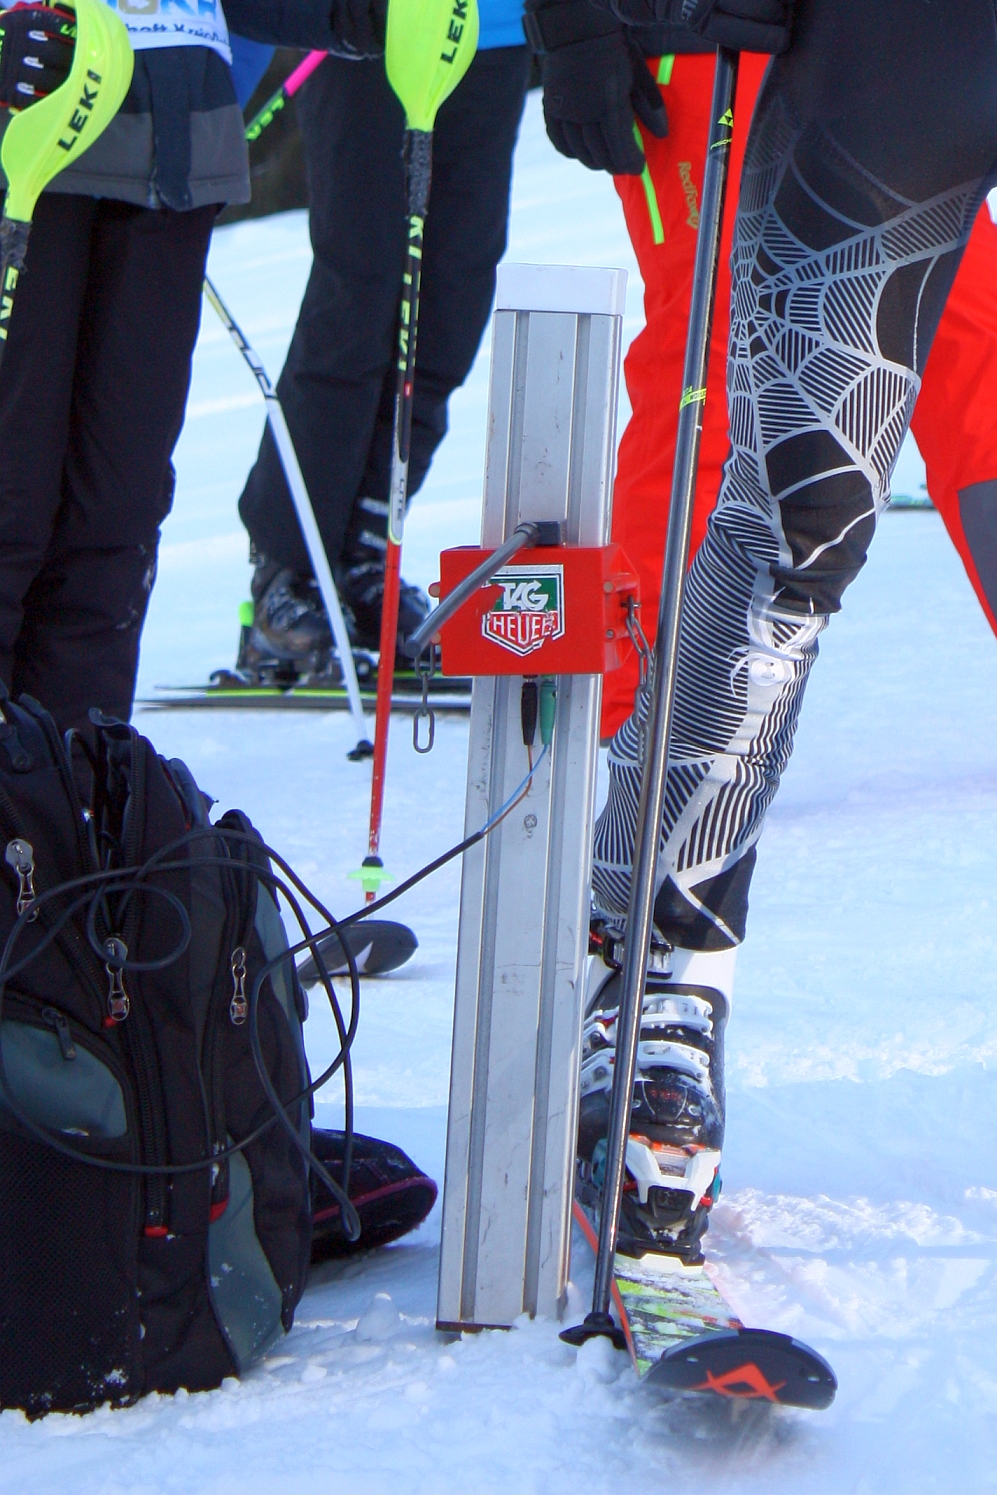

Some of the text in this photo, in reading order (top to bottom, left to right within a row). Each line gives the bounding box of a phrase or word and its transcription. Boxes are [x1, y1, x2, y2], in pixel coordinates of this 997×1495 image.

[57, 69, 103, 153] LEKI
[502, 579, 550, 612] TAG
[492, 612, 557, 646] HEUER
